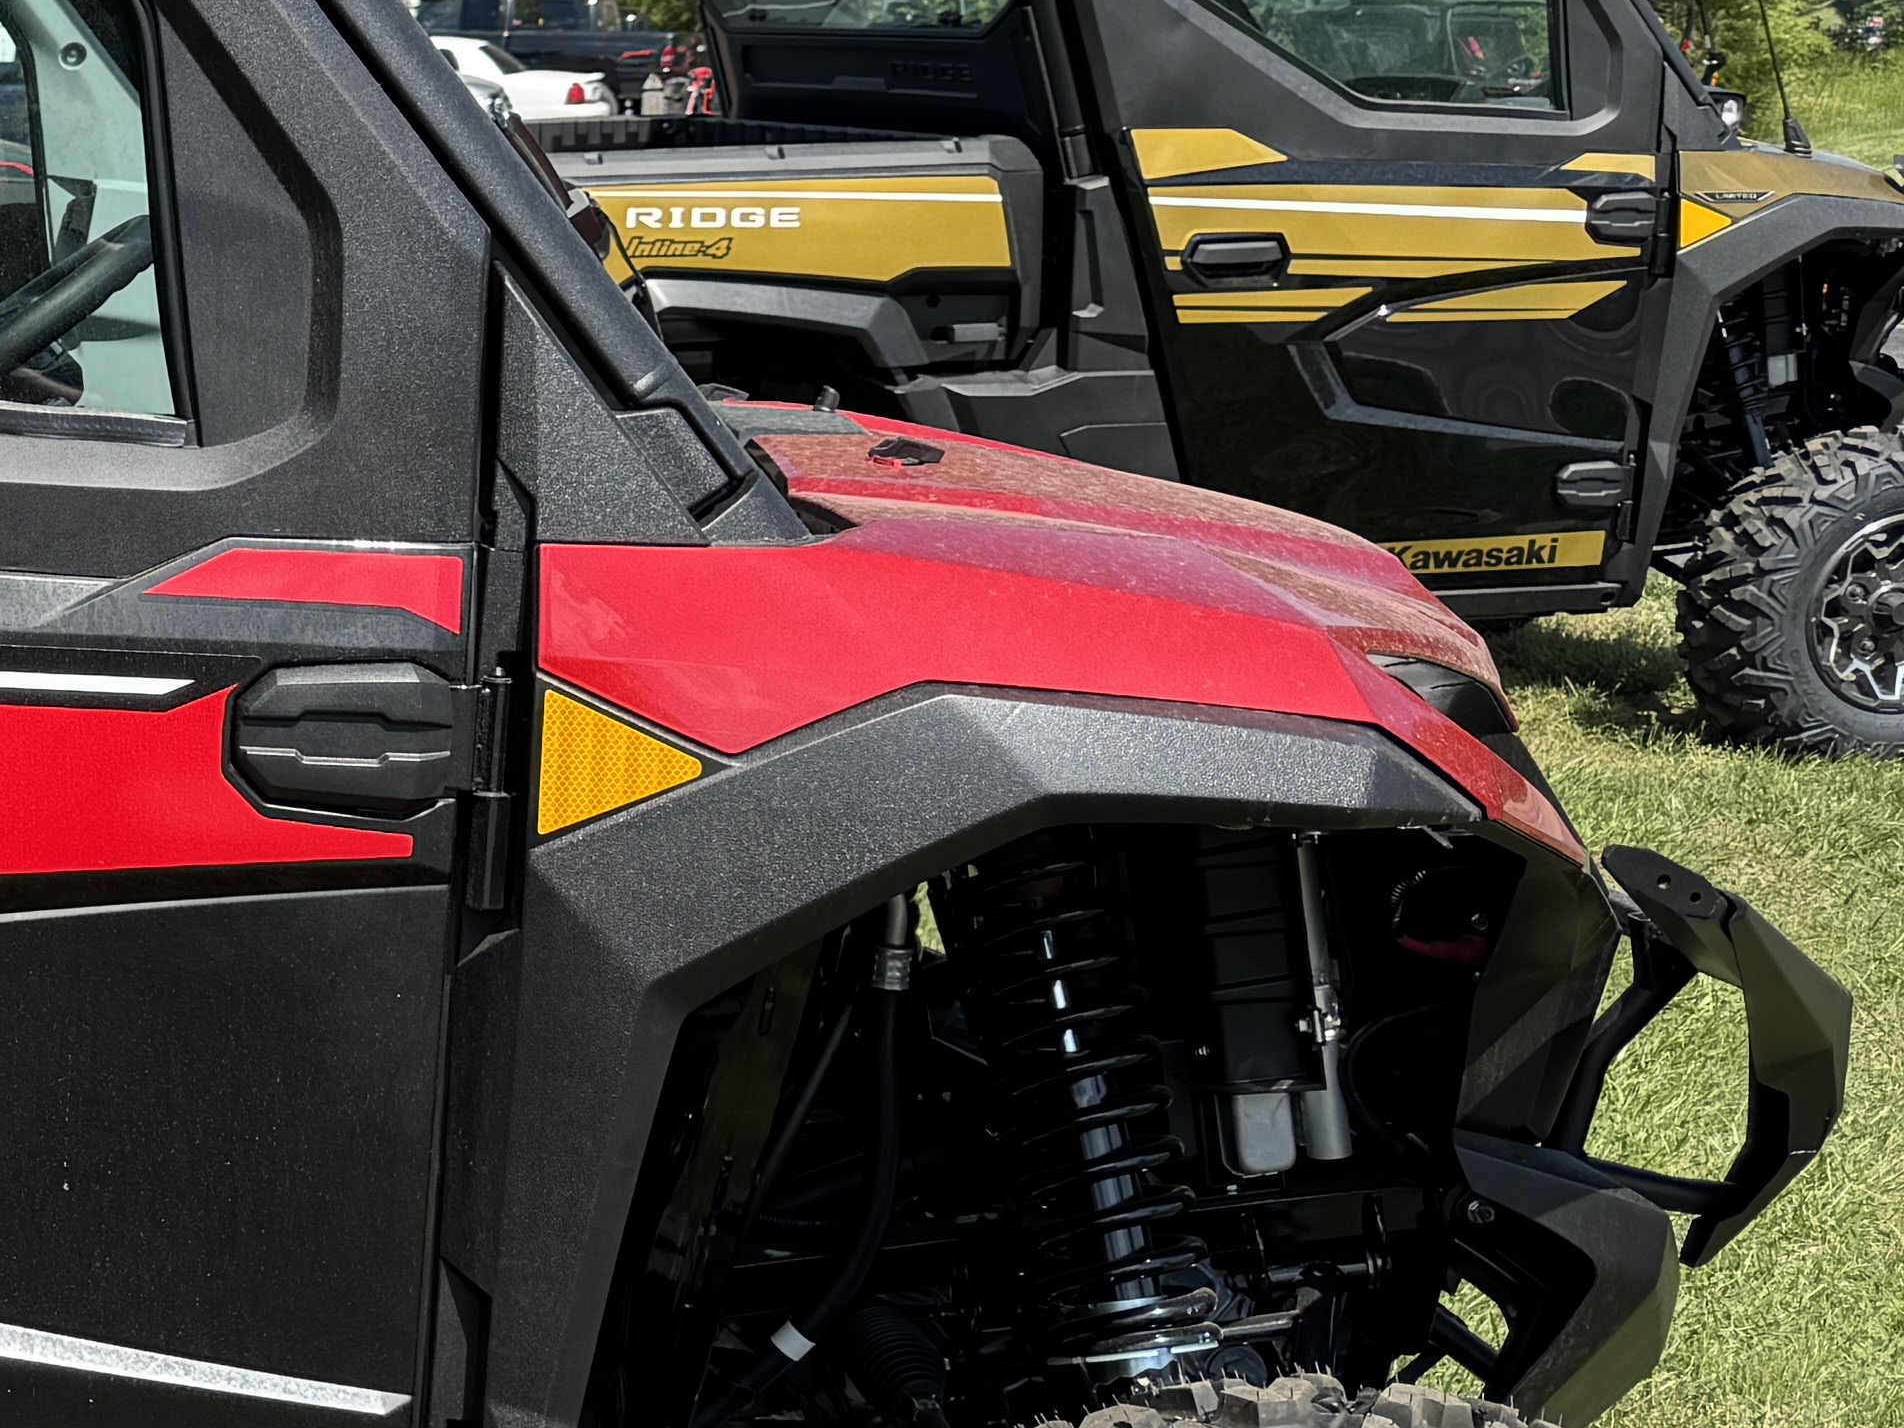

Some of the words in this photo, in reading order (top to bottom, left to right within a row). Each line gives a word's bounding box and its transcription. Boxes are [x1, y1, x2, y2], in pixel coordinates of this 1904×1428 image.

[625, 207, 801, 229] RIDGE
[626, 236, 734, 260] Inline-4
[1385, 537, 1560, 571] Kawasaki
